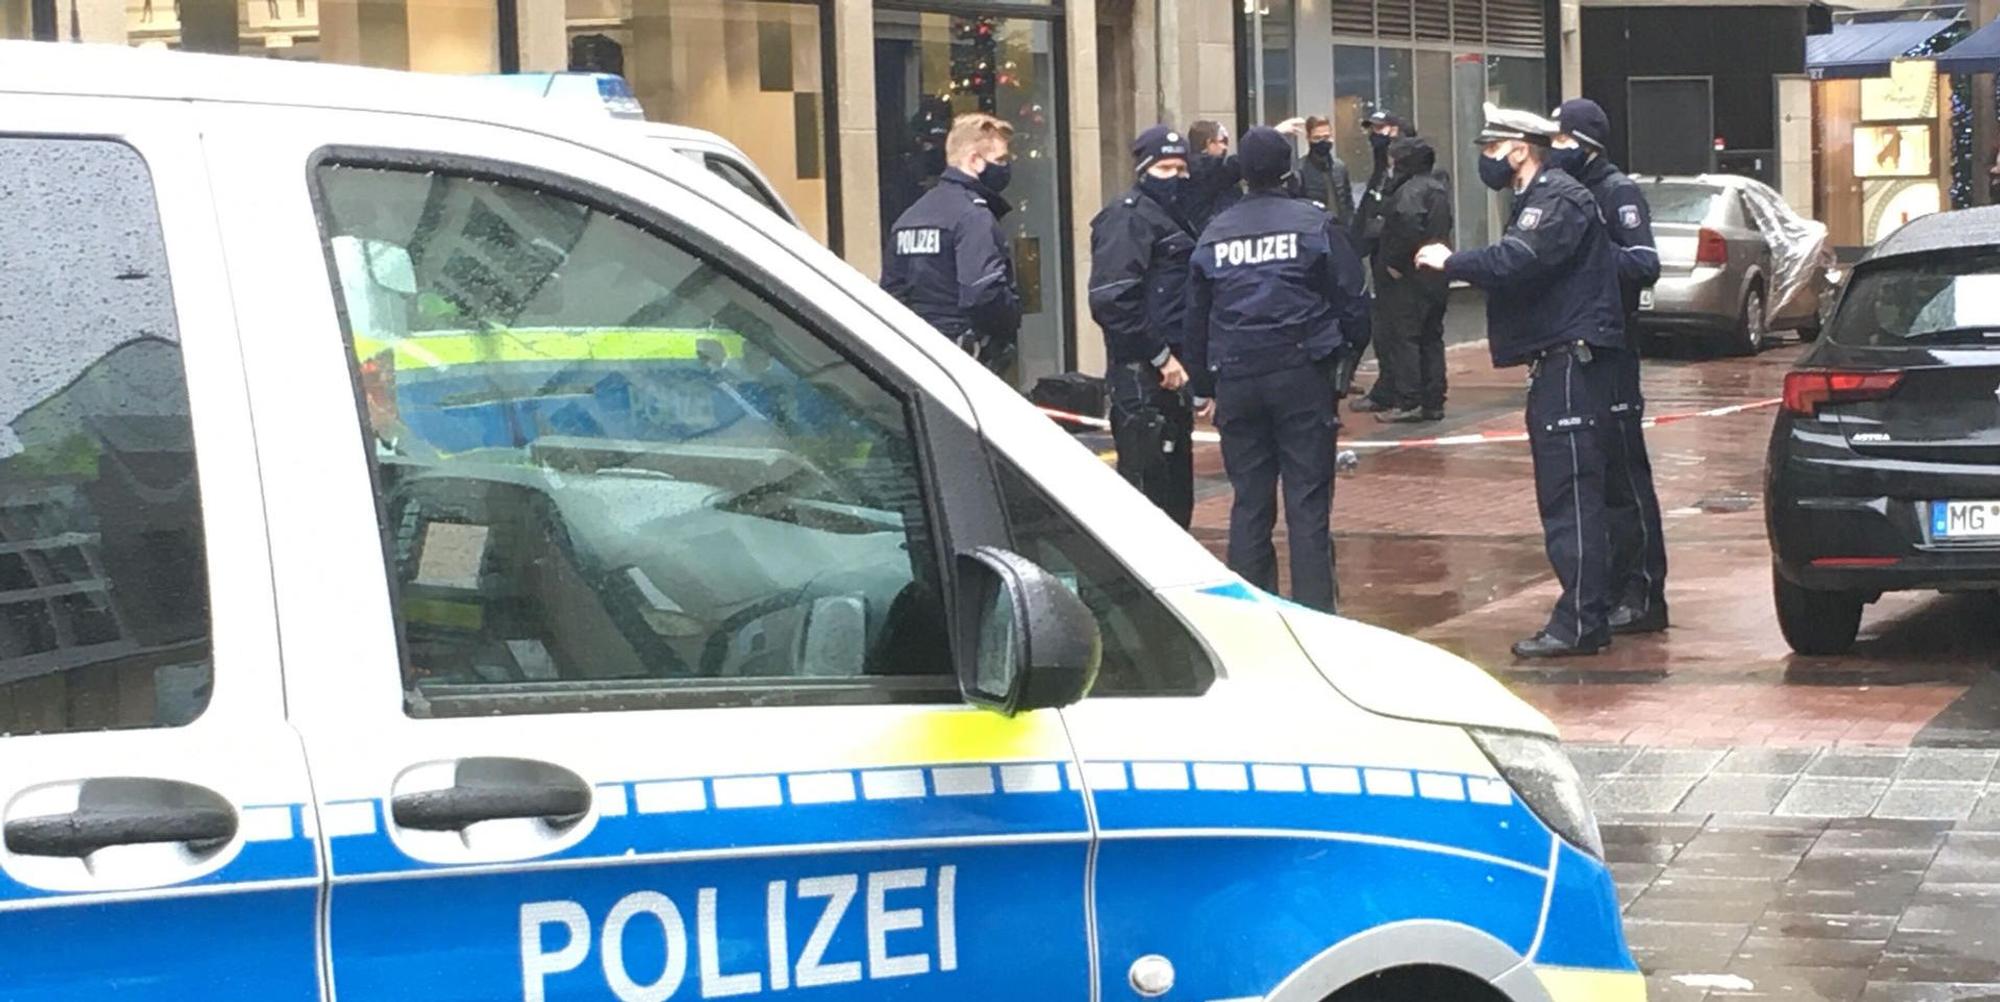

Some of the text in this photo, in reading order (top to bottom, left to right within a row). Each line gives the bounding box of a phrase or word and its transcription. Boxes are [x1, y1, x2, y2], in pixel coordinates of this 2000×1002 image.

[897, 229, 940, 255] POLIZEI
[1214, 233, 1298, 268] POLIZEI
[1852, 432, 1891, 441] ASTRA
[1950, 505, 1985, 531] MG
[519, 865, 957, 1002] POLIZEI
